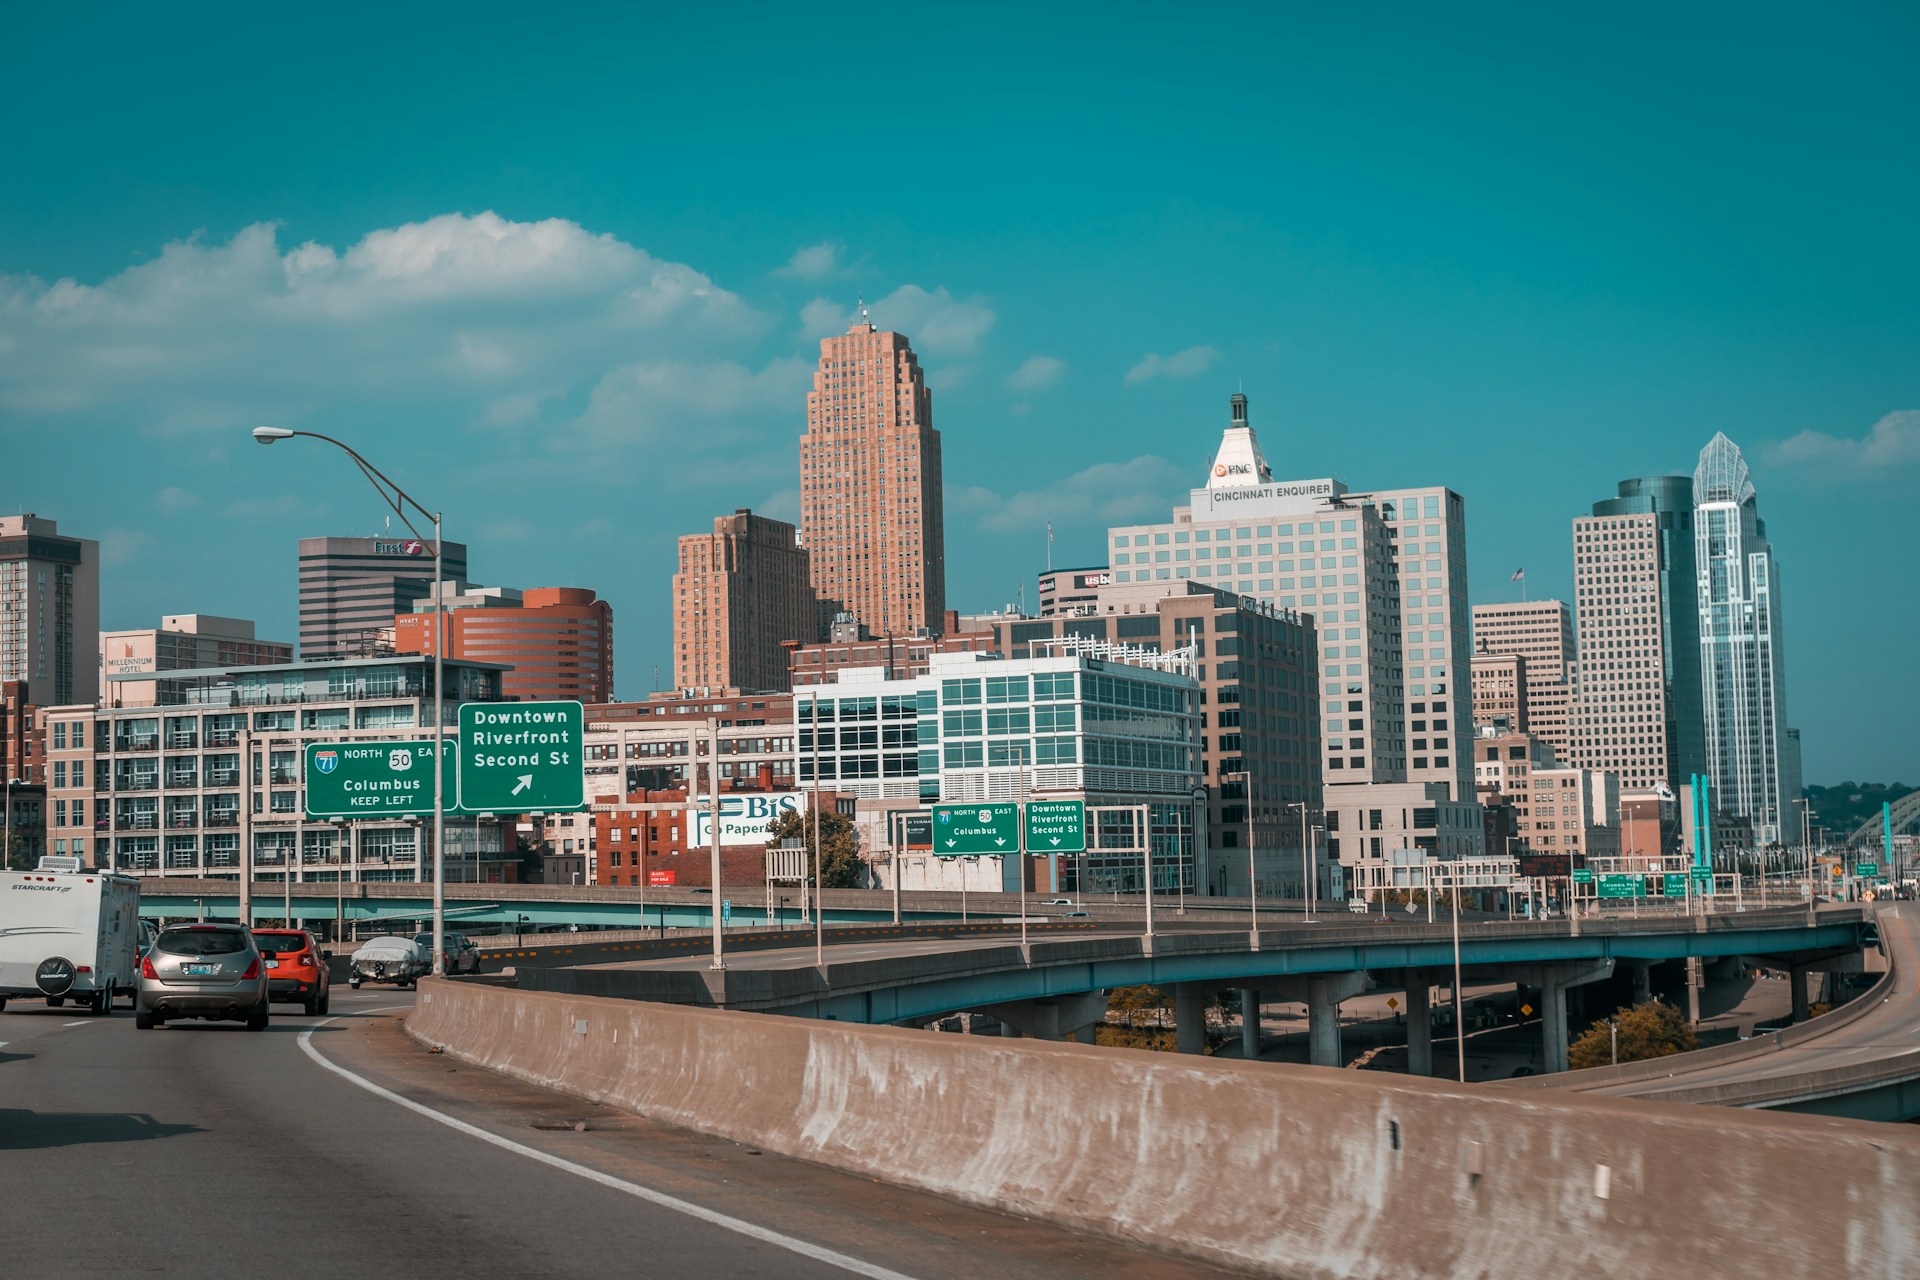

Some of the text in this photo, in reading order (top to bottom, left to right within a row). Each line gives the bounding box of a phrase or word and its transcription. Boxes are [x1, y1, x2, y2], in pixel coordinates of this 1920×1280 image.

[1228, 464, 1251, 474] PNC
[1214, 484, 1330, 502] CINCINNATI ENQUIRER
[374, 542, 404, 554] First
[108, 658, 152, 666] MILLENNIUM
[474, 710, 567, 724] Downtown
[474, 730, 568, 745] Riverfront
[320, 757, 332, 770] 71
[344, 750, 382, 758] NORTH
[392, 754, 410, 766] 50
[418, 748, 448, 756] EAT
[474, 752, 569, 766] Second St
[344, 779, 420, 791] Columbus
[351, 796, 414, 806] KEEP LEFT
[1032, 804, 1076, 812] Downtown
[1032, 815, 1078, 824] Riverfront
[954, 828, 997, 836] Columbus
[1032, 826, 1063, 834] Second
